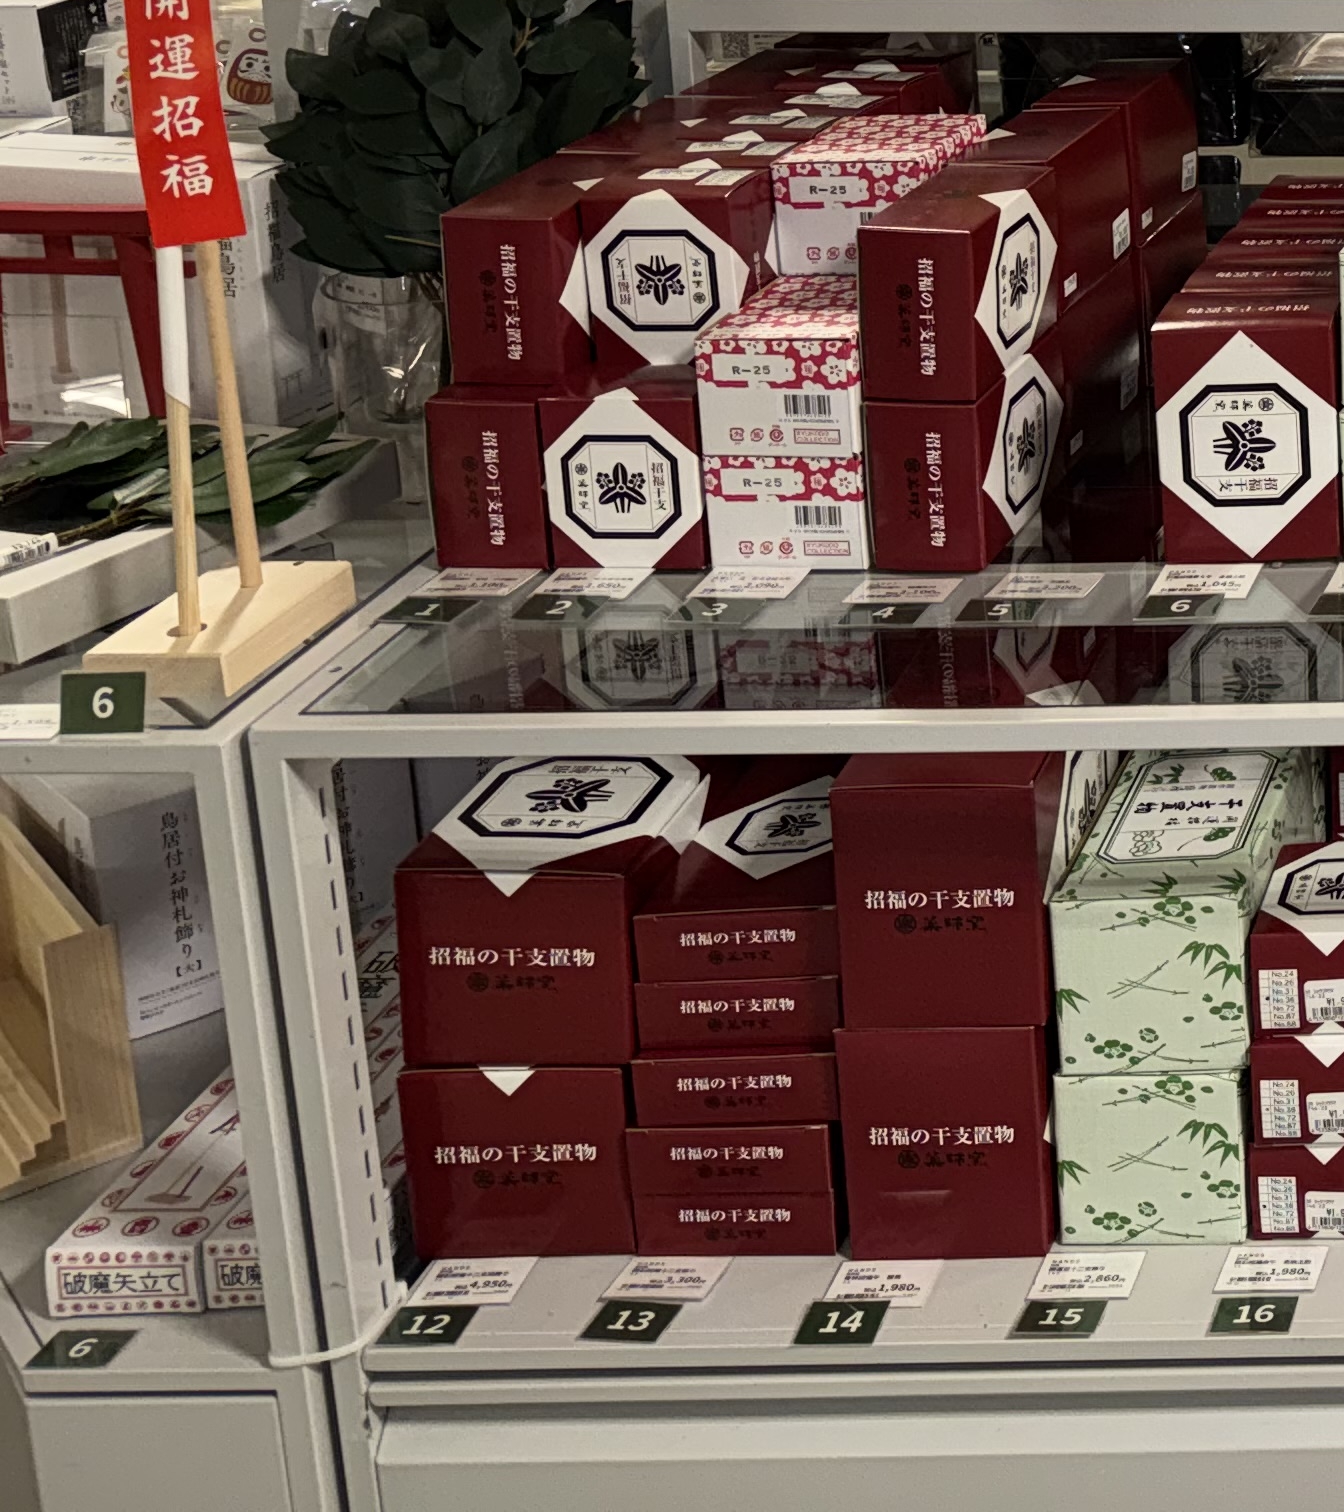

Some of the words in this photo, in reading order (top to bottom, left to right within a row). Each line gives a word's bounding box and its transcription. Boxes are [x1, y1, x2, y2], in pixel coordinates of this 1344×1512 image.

[809, 185, 847, 195] R-25
[731, 364, 770, 376] R-25
[743, 478, 783, 488] R-25
[547, 601, 572, 614] 2
[702, 602, 729, 616] 3
[872, 605, 896, 618] 4
[1170, 600, 1192, 612] 6
[92, 687, 113, 718] 6
[63, 1272, 181, 1294] 破魔矢立て
[607, 1310, 655, 1331] 13
[818, 1311, 864, 1333] 14
[1038, 1309, 1083, 1325] 15
[1232, 1305, 1274, 1323] 16
[402, 1315, 450, 1335] 12
[69, 1338, 98, 1358] 6
